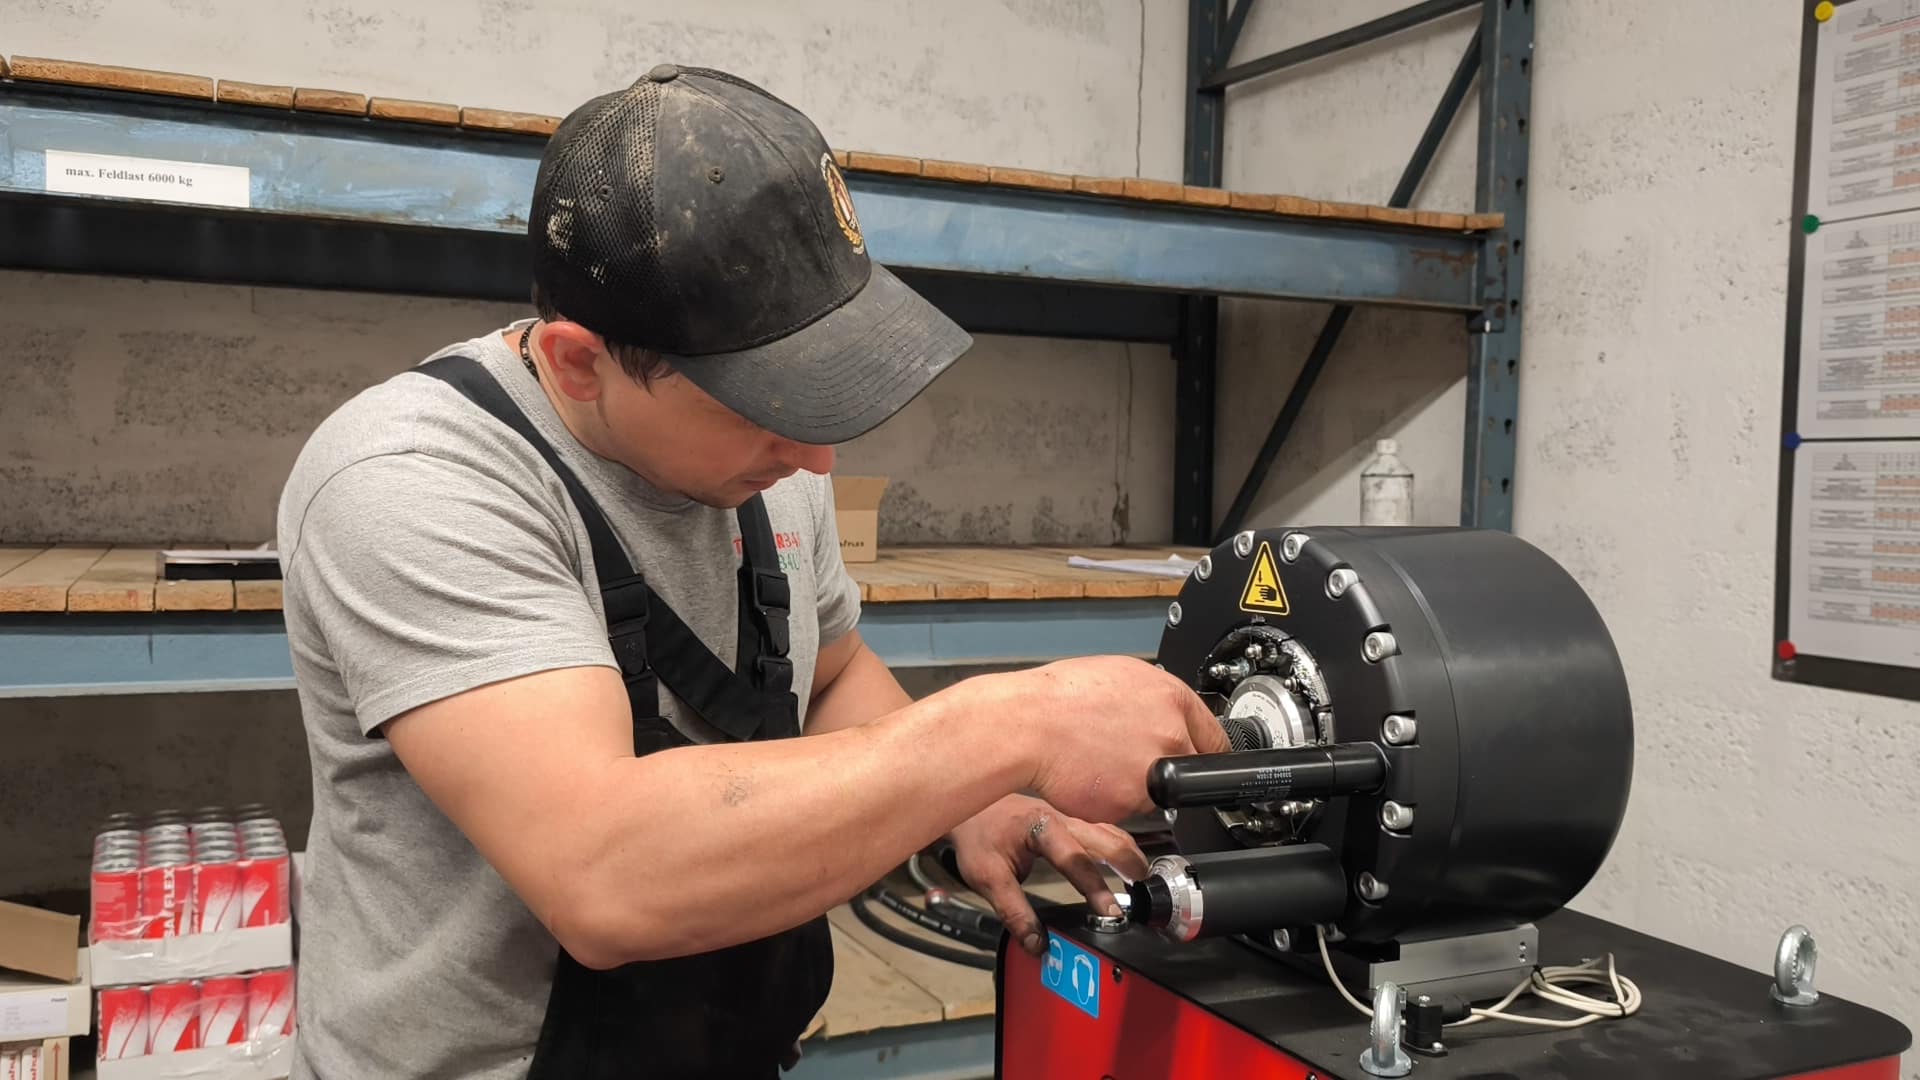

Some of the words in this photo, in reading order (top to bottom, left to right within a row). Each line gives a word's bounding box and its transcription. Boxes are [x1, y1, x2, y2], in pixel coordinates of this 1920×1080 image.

[65, 168, 95, 178] max.
[98, 168, 145, 182] Feldlast
[148, 173, 175, 184] 6000
[178, 175, 193, 187] kg
